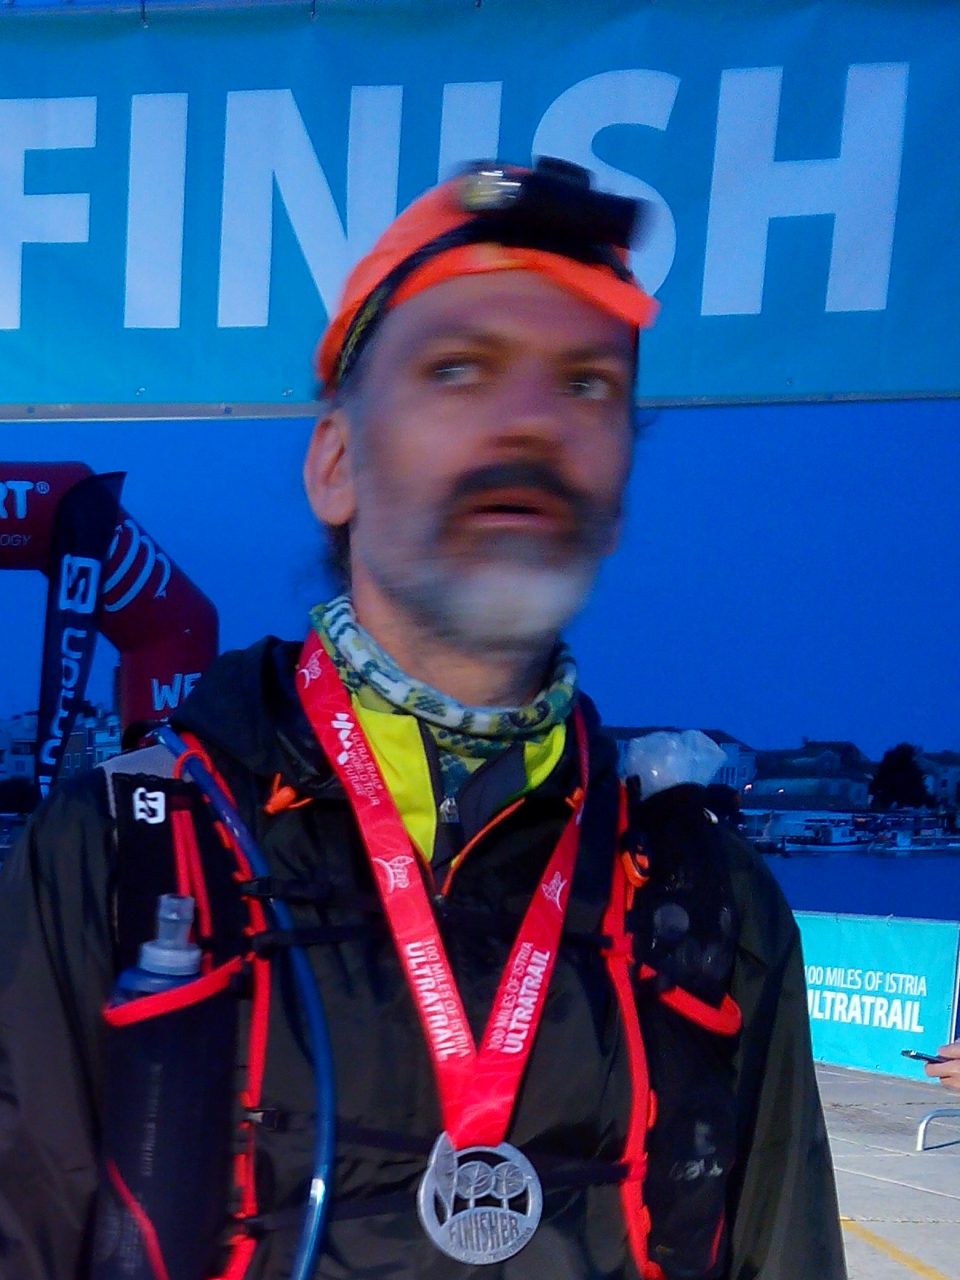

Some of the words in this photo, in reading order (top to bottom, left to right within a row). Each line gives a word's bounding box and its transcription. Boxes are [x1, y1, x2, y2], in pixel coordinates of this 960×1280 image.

[511, 941, 534, 977] ISTRIA
[431, 962, 452, 999] MILES
[504, 976, 521, 993] OF
[825, 966, 862, 990] MILES
[864, 970, 884, 992] OF
[886, 972, 927, 998] ISTRIA
[404, 940, 457, 1062] ULTRATRAIL
[444, 999, 460, 1017] OF
[494, 993, 518, 1028] MILES
[500, 949, 550, 1054] ULTRATRAIL
[450, 1018, 471, 1058] ISTRIA
[447, 1210, 520, 1252] FINISHER
